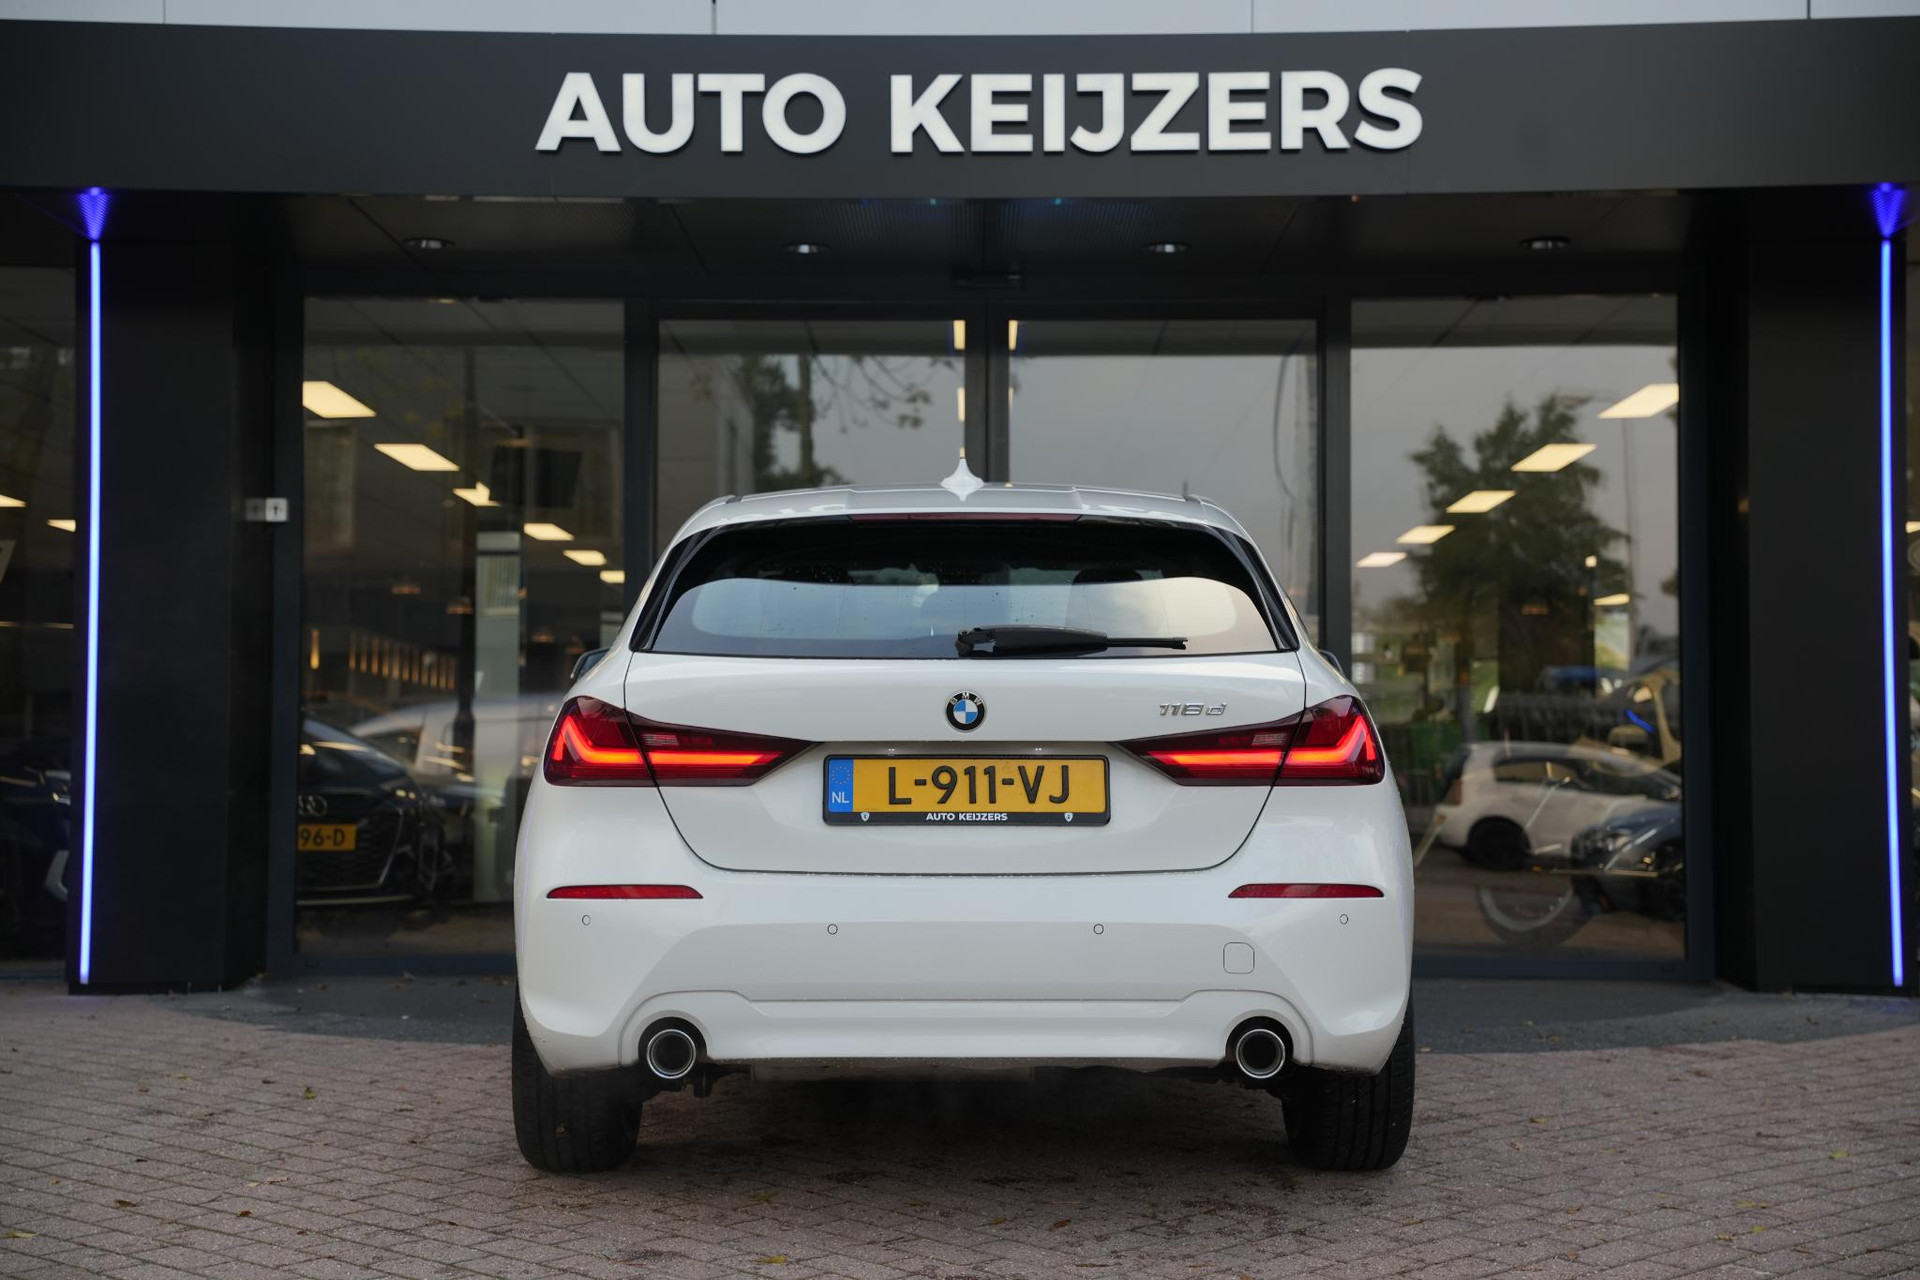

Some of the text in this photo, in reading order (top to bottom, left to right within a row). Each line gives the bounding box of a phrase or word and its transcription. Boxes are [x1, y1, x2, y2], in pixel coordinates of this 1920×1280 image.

[535, 67, 1423, 155] AUTO KEIJZERS
[950, 692, 984, 706] BMW
[1159, 702, 1228, 717] 118d
[888, 765, 1070, 805] L-911-VJ
[832, 792, 849, 804] NL
[926, 812, 1008, 822] AUTO KEIJZERS
